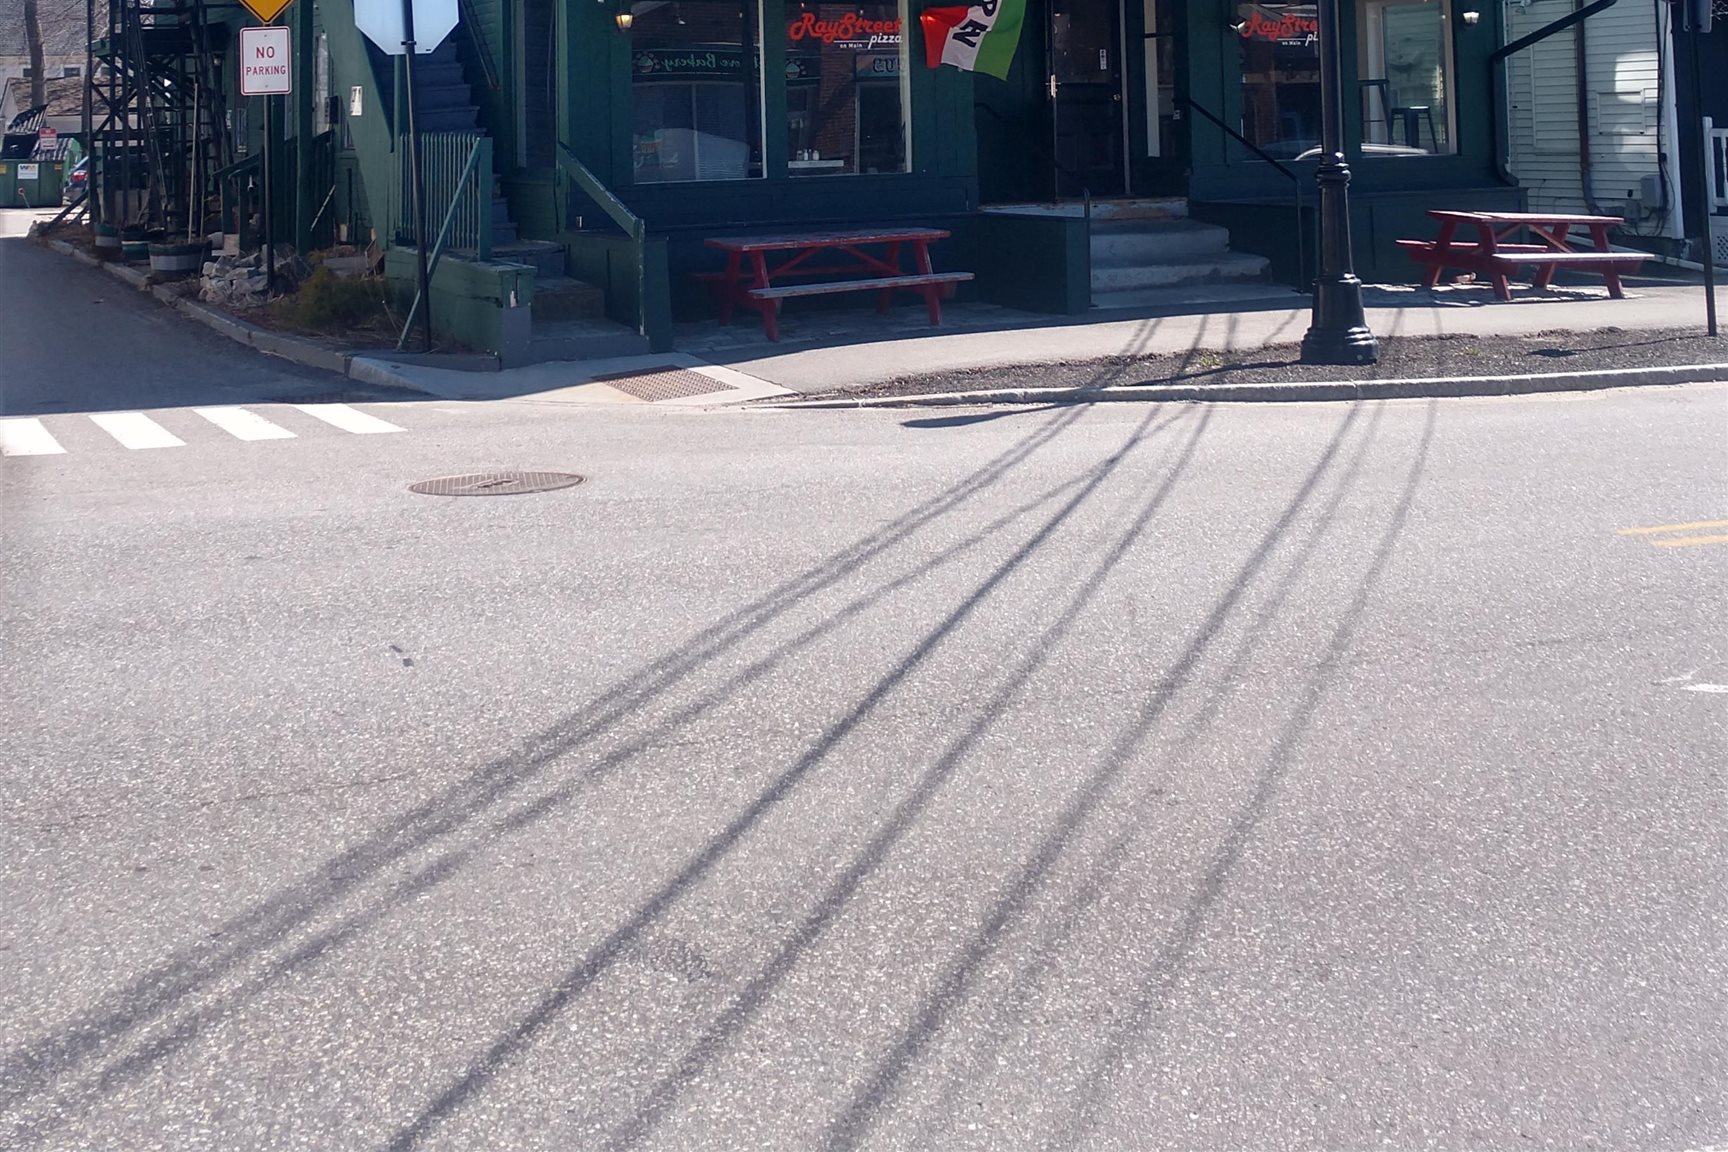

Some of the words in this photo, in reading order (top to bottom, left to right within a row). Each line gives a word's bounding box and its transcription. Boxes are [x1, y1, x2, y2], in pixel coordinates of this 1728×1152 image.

[1242, 11, 1318, 41] RayStre
[867, 32, 902, 50] pizza
[256, 46, 275, 59] NO
[246, 65, 287, 76] PARKING
